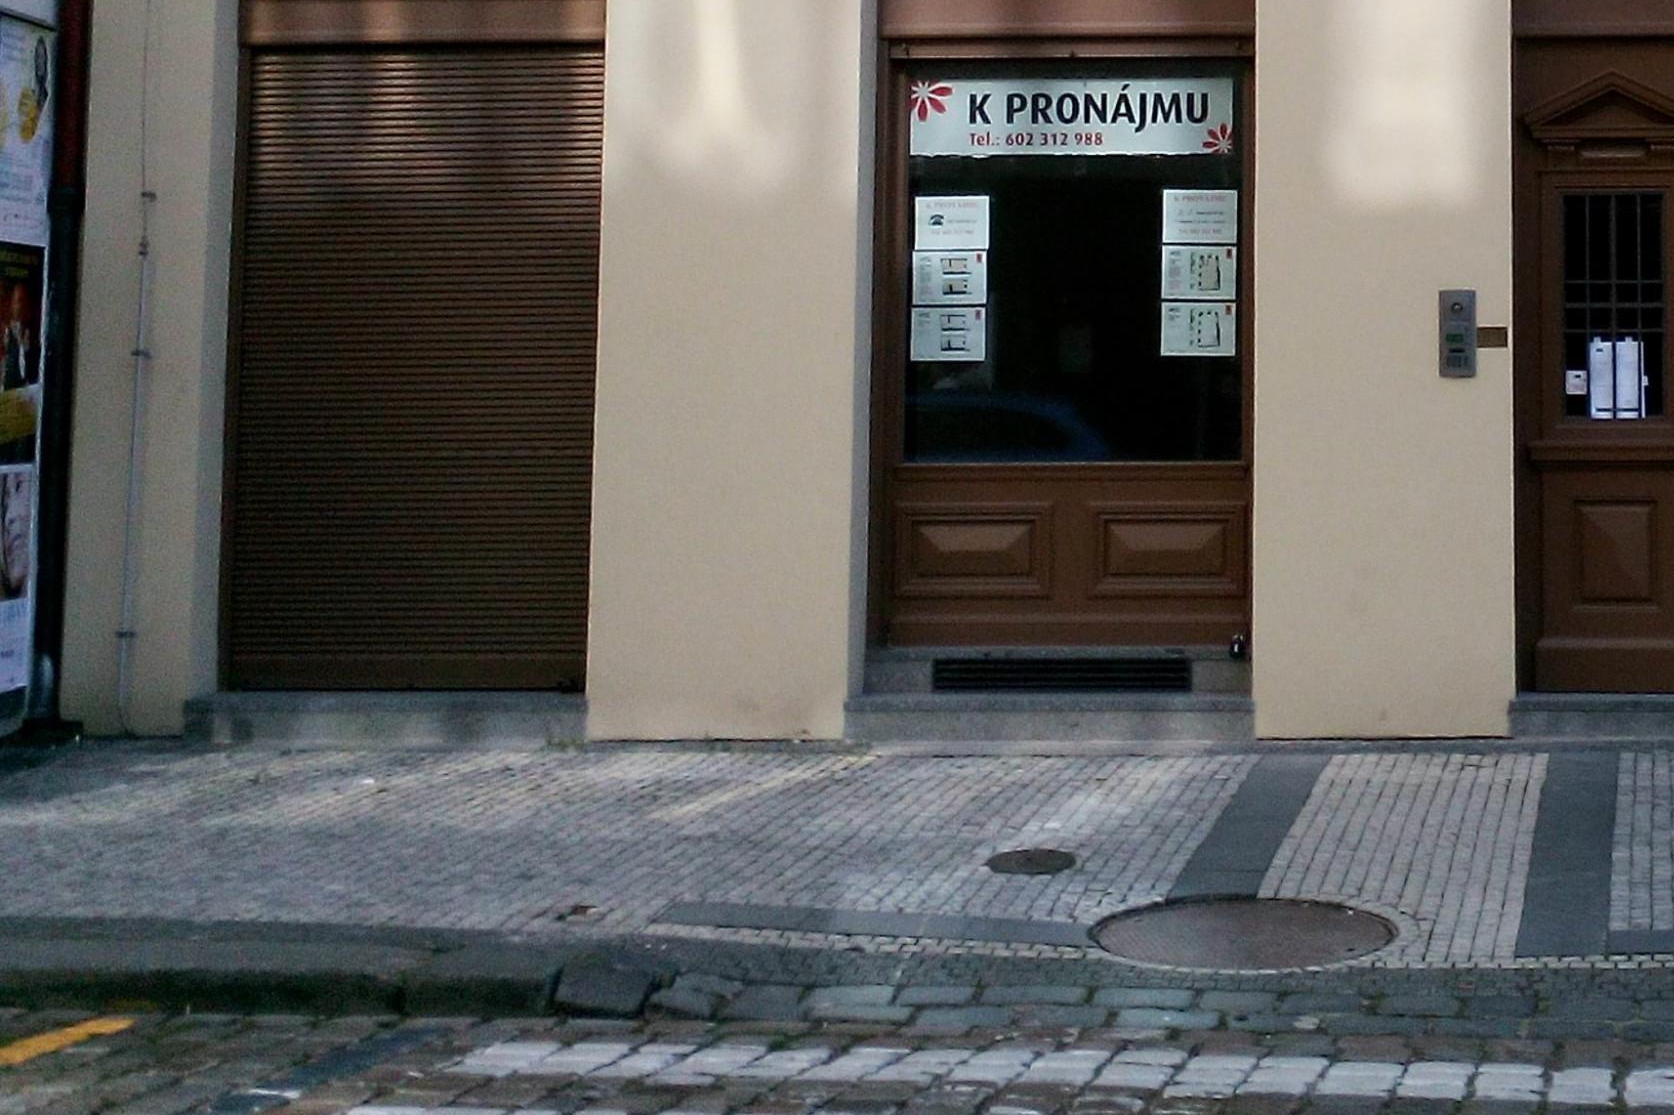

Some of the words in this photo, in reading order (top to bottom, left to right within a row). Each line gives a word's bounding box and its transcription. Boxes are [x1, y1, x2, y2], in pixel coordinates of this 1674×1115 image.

[968, 93, 992, 125] K
[1006, 83, 1209, 133] PRONÁJMU
[969, 132, 1001, 147] Tel.:
[1005, 132, 1034, 147] 602
[1039, 132, 1068, 147] 312
[1074, 132, 1104, 147] 988
